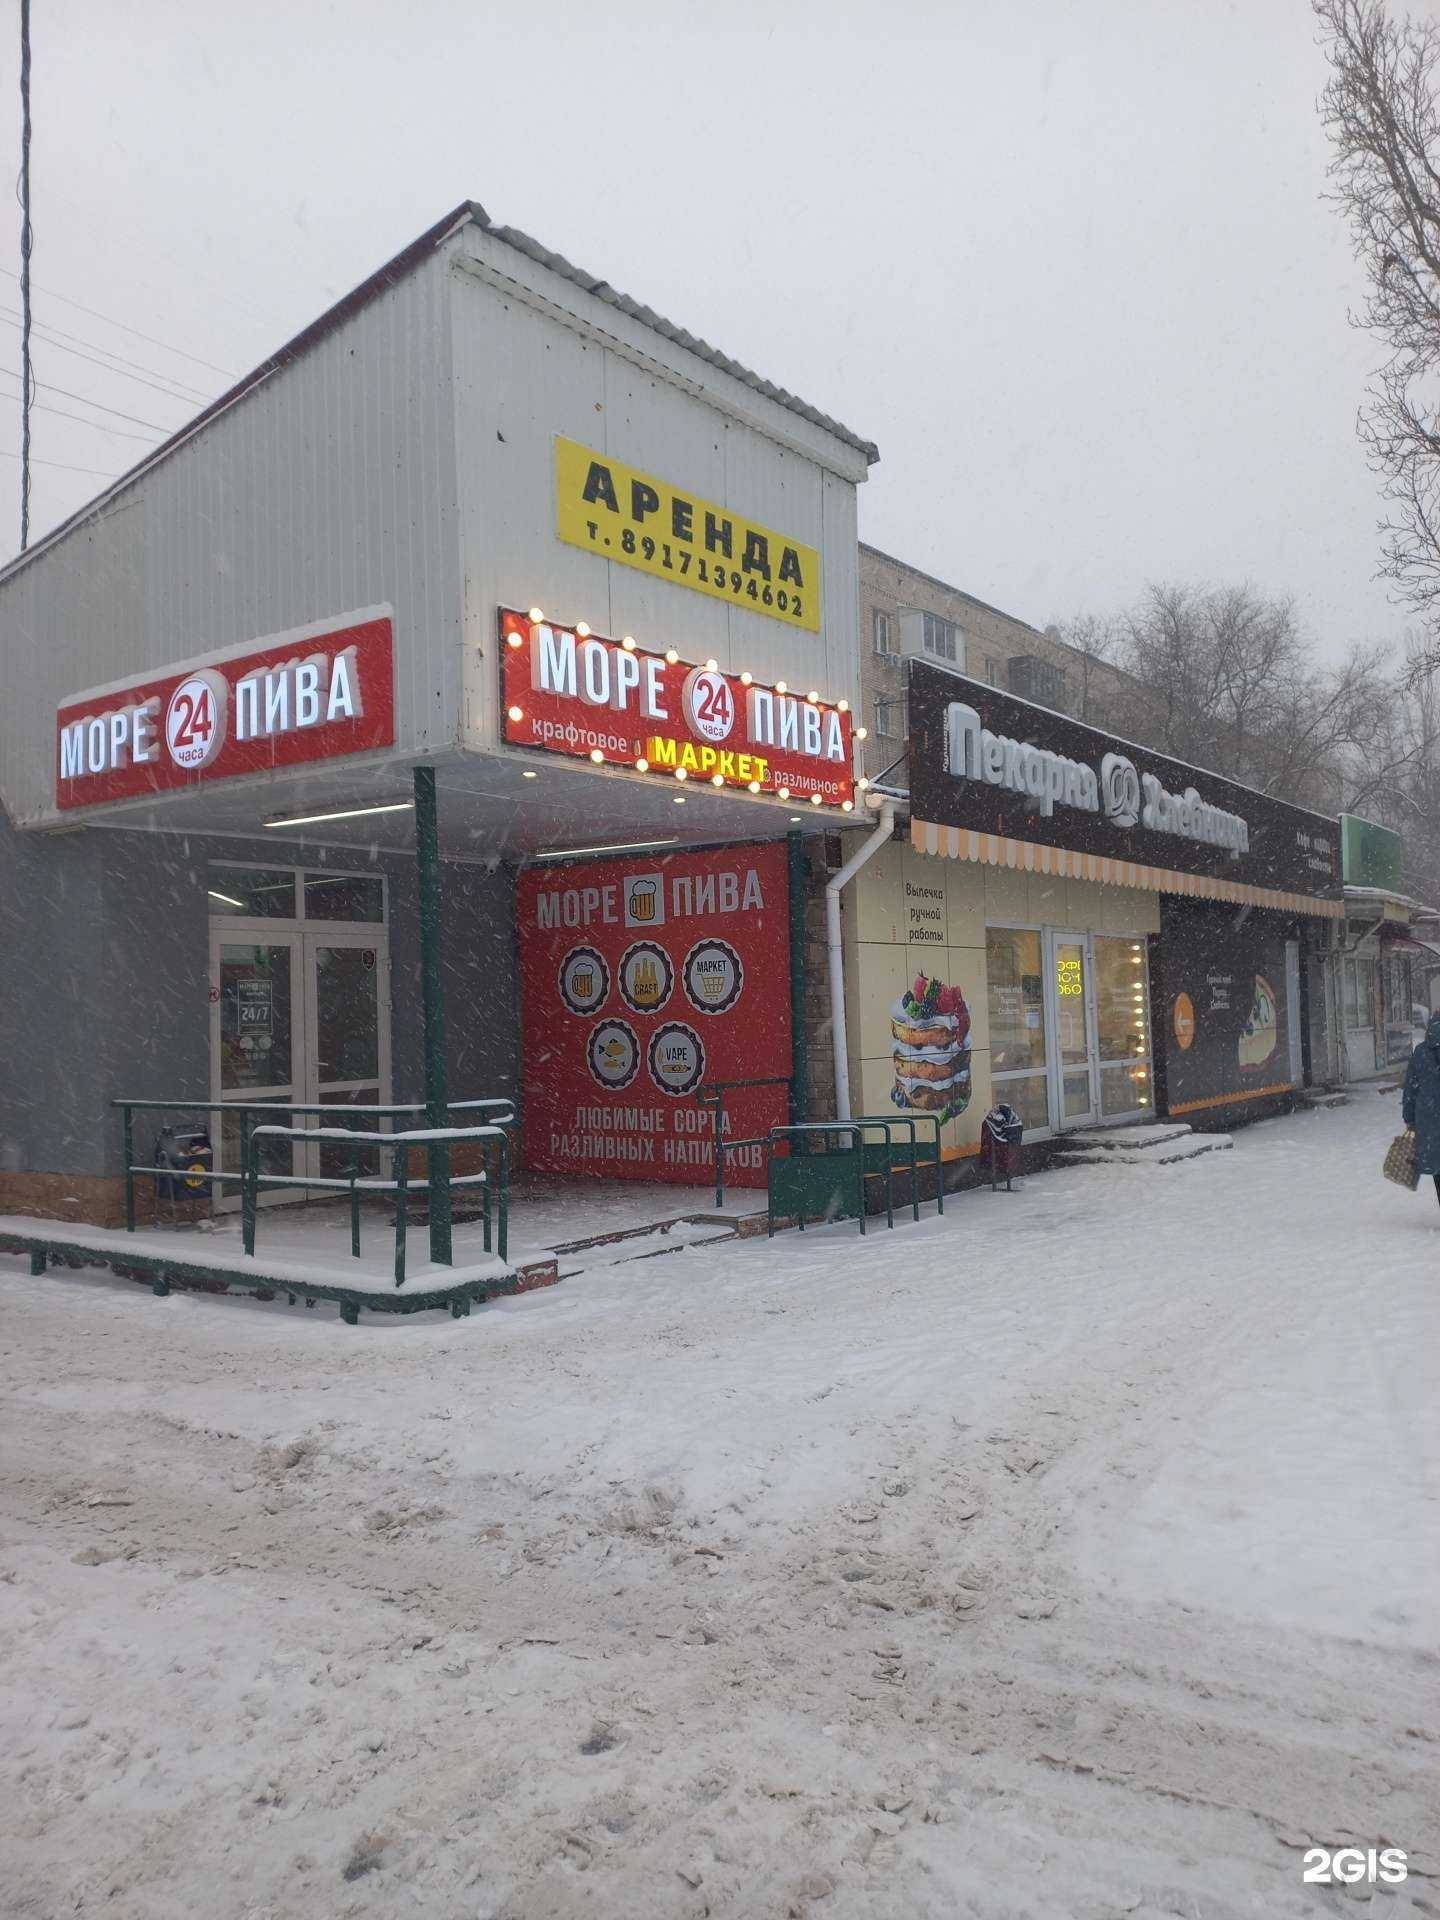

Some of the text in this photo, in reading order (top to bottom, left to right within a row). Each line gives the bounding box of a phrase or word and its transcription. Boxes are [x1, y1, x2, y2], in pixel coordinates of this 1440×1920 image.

[582, 461, 804, 588] АРЕНДА
[536, 625, 845, 762] МОРЕ 24 ПИВА
[60, 654, 354, 779] МОРЕ 24 ПИВА
[532, 718, 627, 753] крафтовое
[702, 724, 725, 738] часа
[178, 748, 204, 762] часа
[653, 736, 768, 782] МАРКЕТ
[948, 702, 1098, 817] Пекарня
[774, 770, 838, 795] разливное
[536, 869, 764, 929] МОРЕ ПИВА
[905, 883, 943, 899] Выпечка
[910, 908, 941, 922] ручной
[909, 927, 943, 942] работы
[696, 960, 727, 972] МАРКЕТ
[241, 1007, 268, 1021] 24/7
[665, 1047, 687, 1060] VAPE
[574, 1106, 732, 1134] ЛЮБИМЫЕ СОРТА
[550, 1134, 763, 1168] РАЗЛИВНЫХ НАПИКОВ
